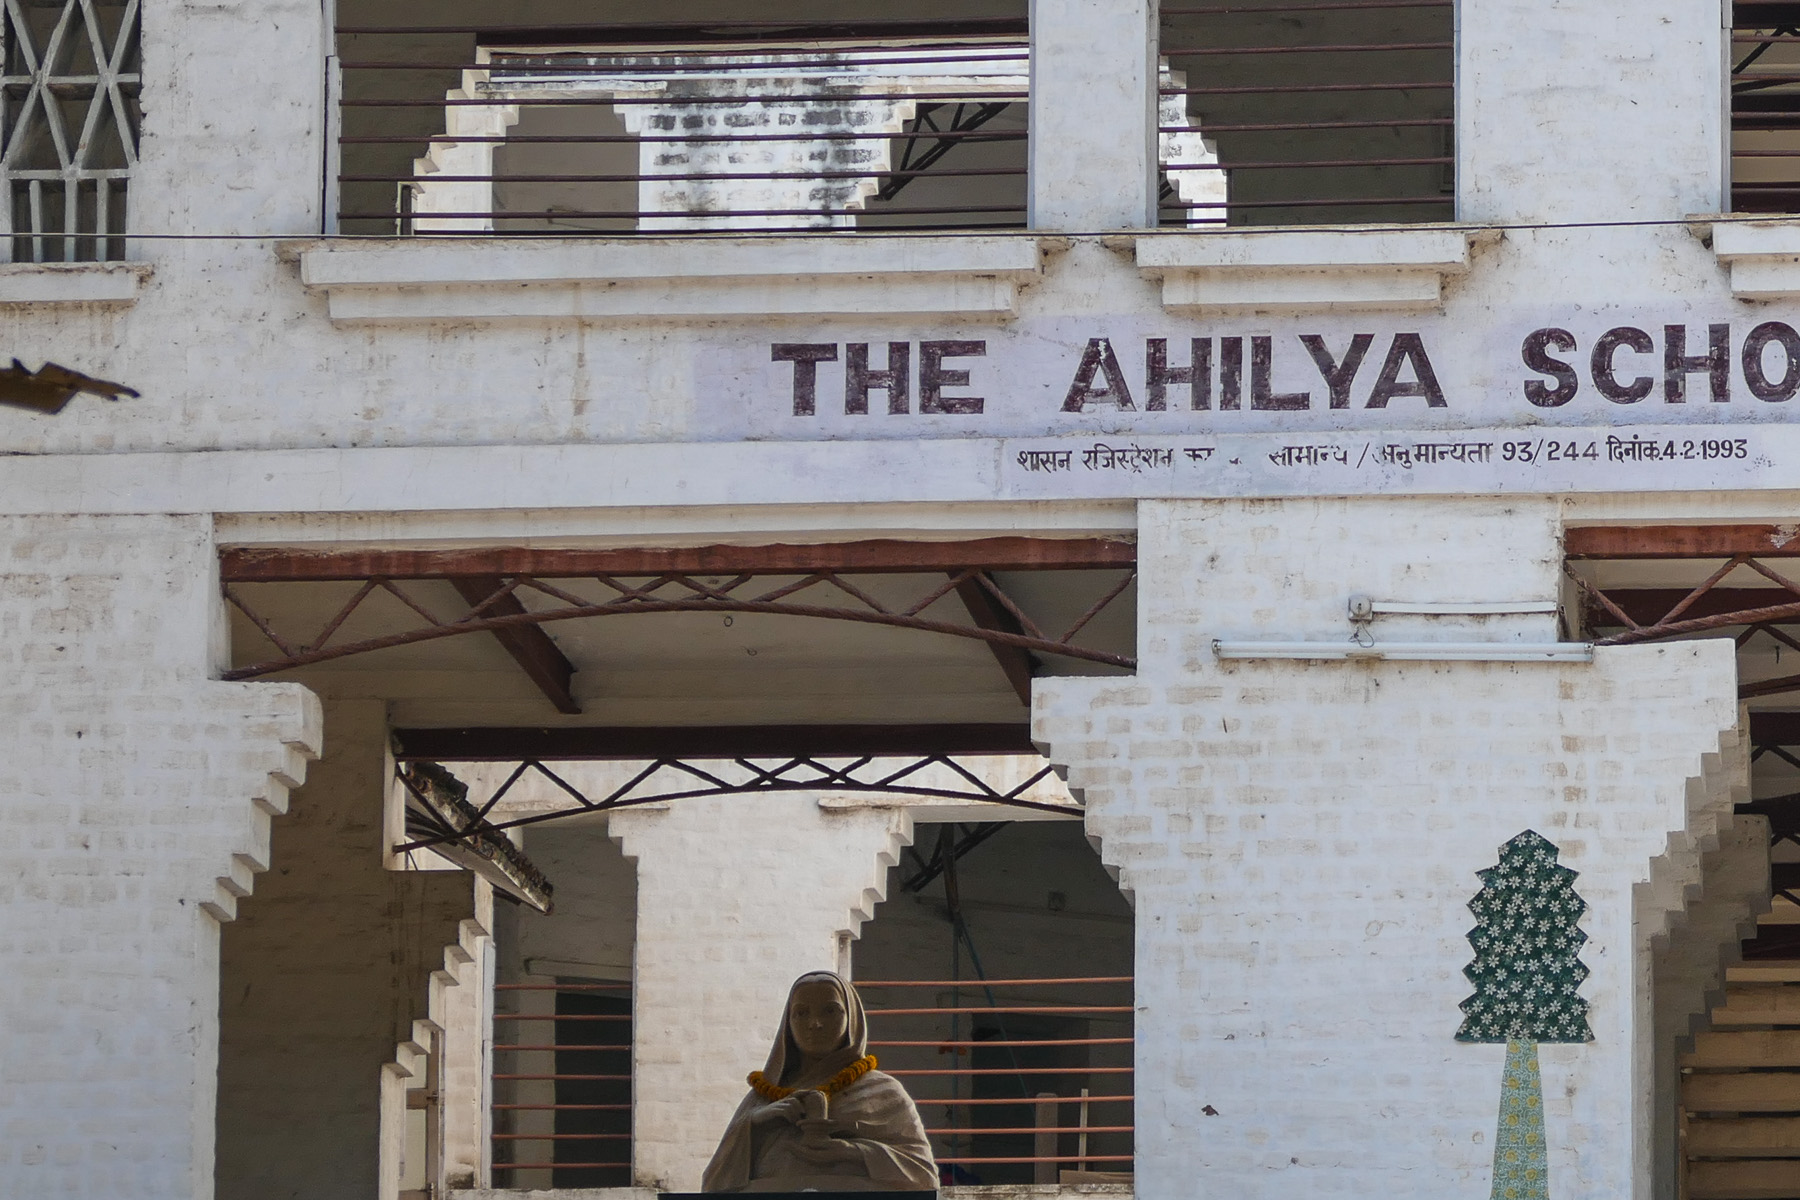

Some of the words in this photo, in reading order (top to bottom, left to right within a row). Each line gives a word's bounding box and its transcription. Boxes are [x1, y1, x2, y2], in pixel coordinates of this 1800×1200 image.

[770, 340, 987, 417] THE
[1059, 332, 1449, 413] AHILYA
[1016, 449, 1073, 474] शासन
[1501, 438, 1600, 466] 93/244
